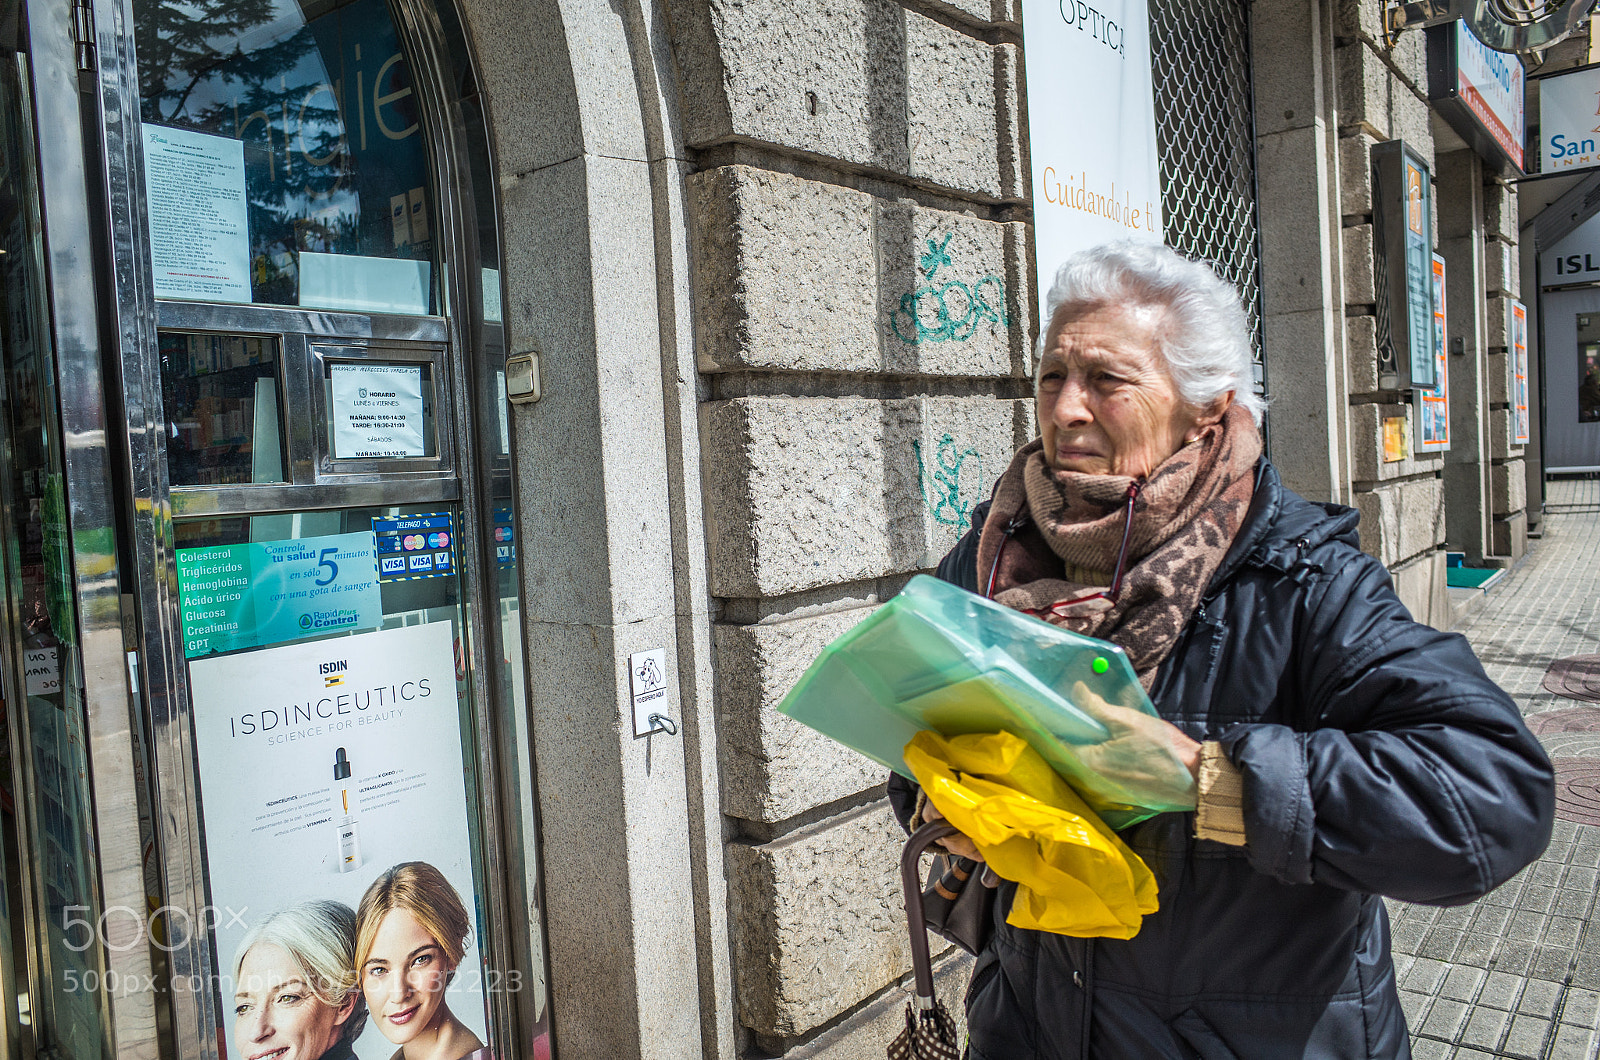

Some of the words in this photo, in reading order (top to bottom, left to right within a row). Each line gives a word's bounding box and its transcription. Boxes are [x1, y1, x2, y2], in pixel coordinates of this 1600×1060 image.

[1550, 134, 1594, 158] San
[1043, 166, 1120, 223] Cuidando
[1123, 190, 1140, 229] de
[1145, 201, 1154, 233] ti
[1556, 253, 1600, 275] ISL
[396, 520, 421, 529] TELEPAGO
[180, 549, 232, 563] Colesterol
[264, 543, 306, 555] Controla
[272, 555, 284, 563] tu
[287, 550, 316, 561] salud
[334, 550, 369, 560] minutos
[181, 563, 243, 578] Triglicéridos
[315, 547, 339, 586] 5
[384, 559, 404, 569] VISA
[412, 557, 431, 566] VISA
[289, 572, 301, 580] en
[303, 567, 321, 578] sólo
[183, 577, 248, 592] Hemoglobina
[269, 593, 286, 602] con
[289, 590, 307, 599] una
[309, 587, 329, 599] gota
[331, 583, 342, 593] de
[344, 581, 372, 592] sangre
[184, 594, 213, 607] Ácido
[216, 592, 241, 603] úrico
[186, 609, 226, 622] Glucosa
[313, 609, 338, 620] Rapid
[338, 609, 357, 617] Plus
[314, 614, 358, 628] Control
[187, 621, 239, 636] Creatinina
[188, 638, 209, 651] GPT
[319, 659, 348, 675] ISDIN
[230, 678, 432, 738] ISDINCEUTICS
[268, 726, 323, 746] SCIENCE
[328, 719, 353, 733] FOR
[358, 709, 405, 726] BEAUTY
